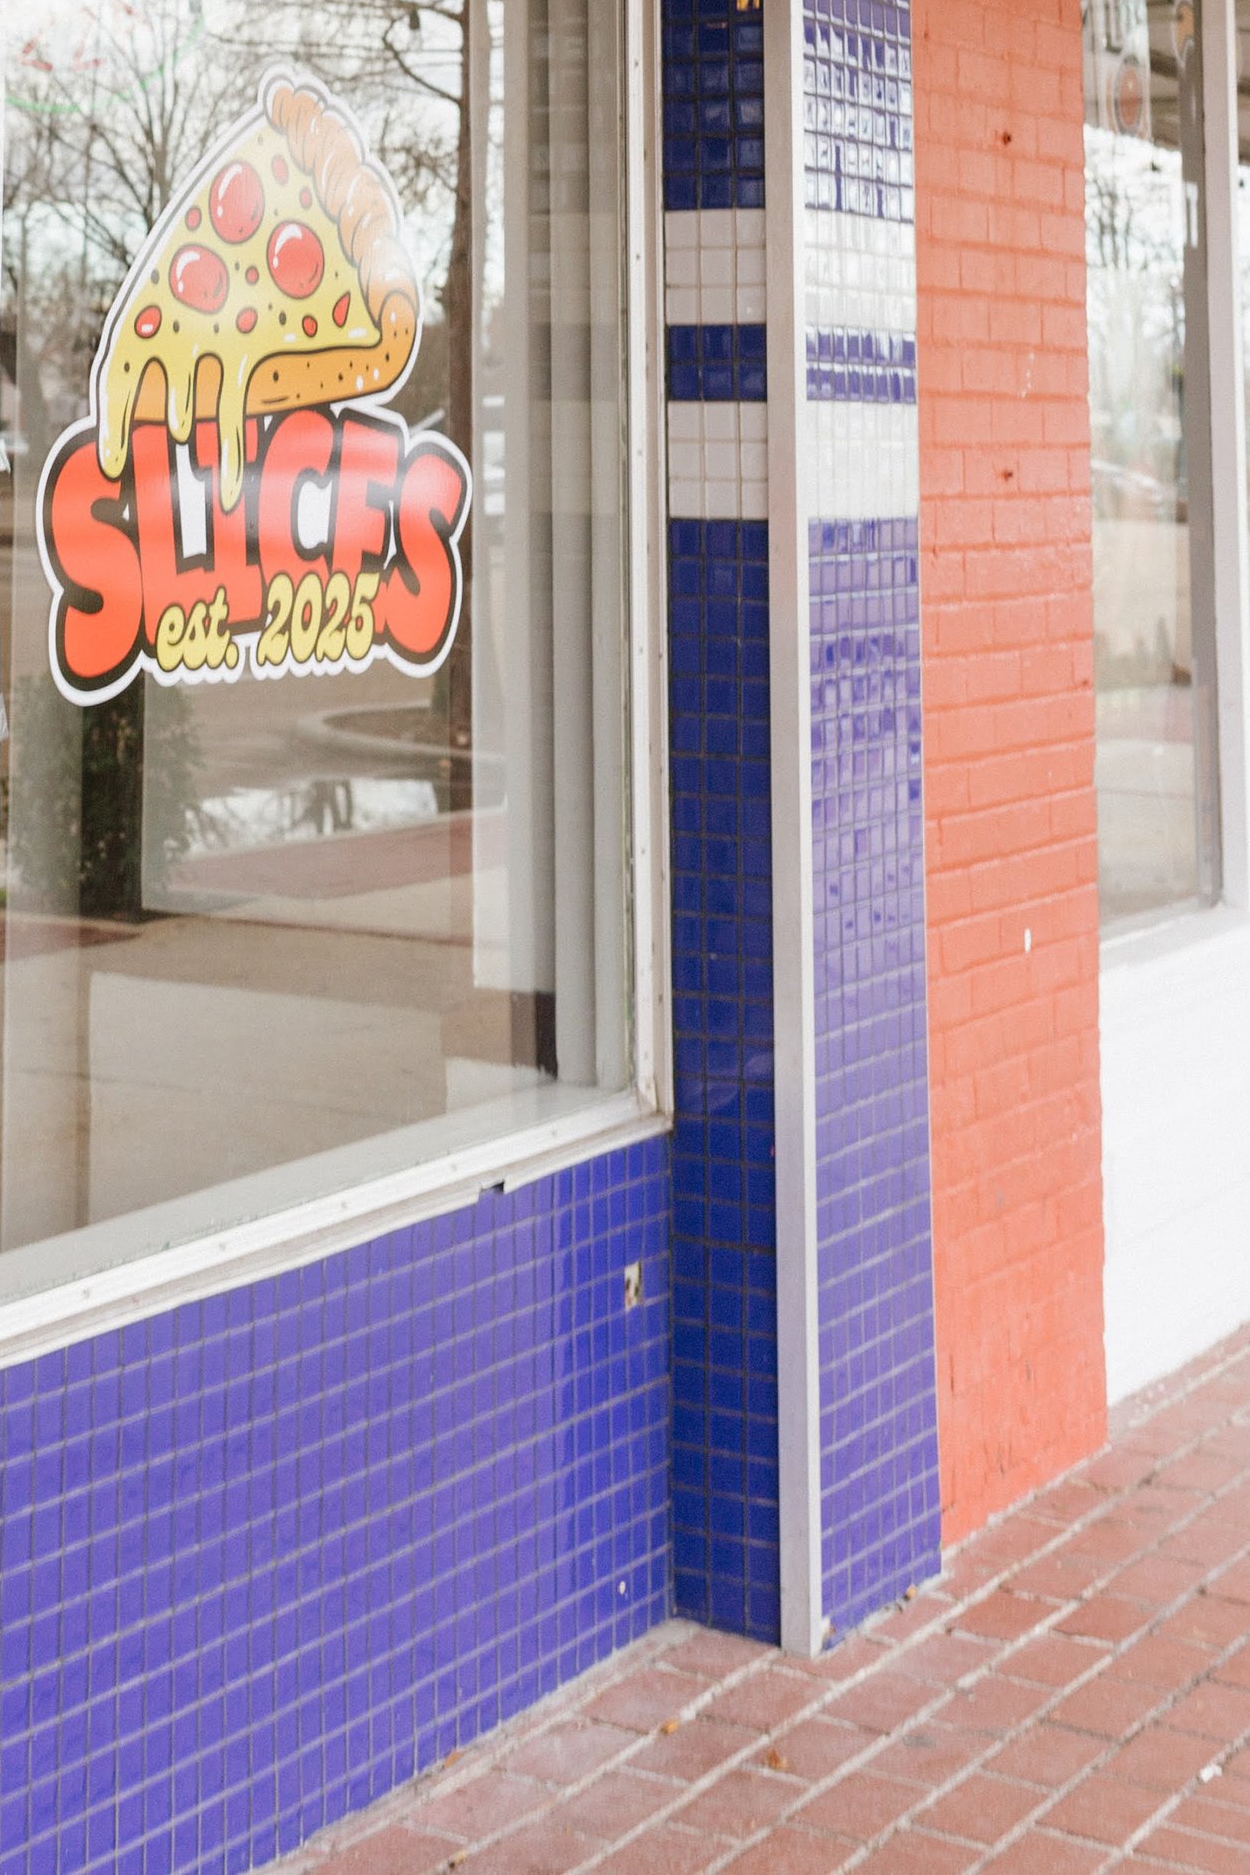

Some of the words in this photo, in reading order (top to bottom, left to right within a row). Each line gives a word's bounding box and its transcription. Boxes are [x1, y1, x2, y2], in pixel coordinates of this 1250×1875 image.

[52, 409, 463, 680] SLICES
[156, 585, 240, 672] est.
[256, 571, 381, 667] 2025
